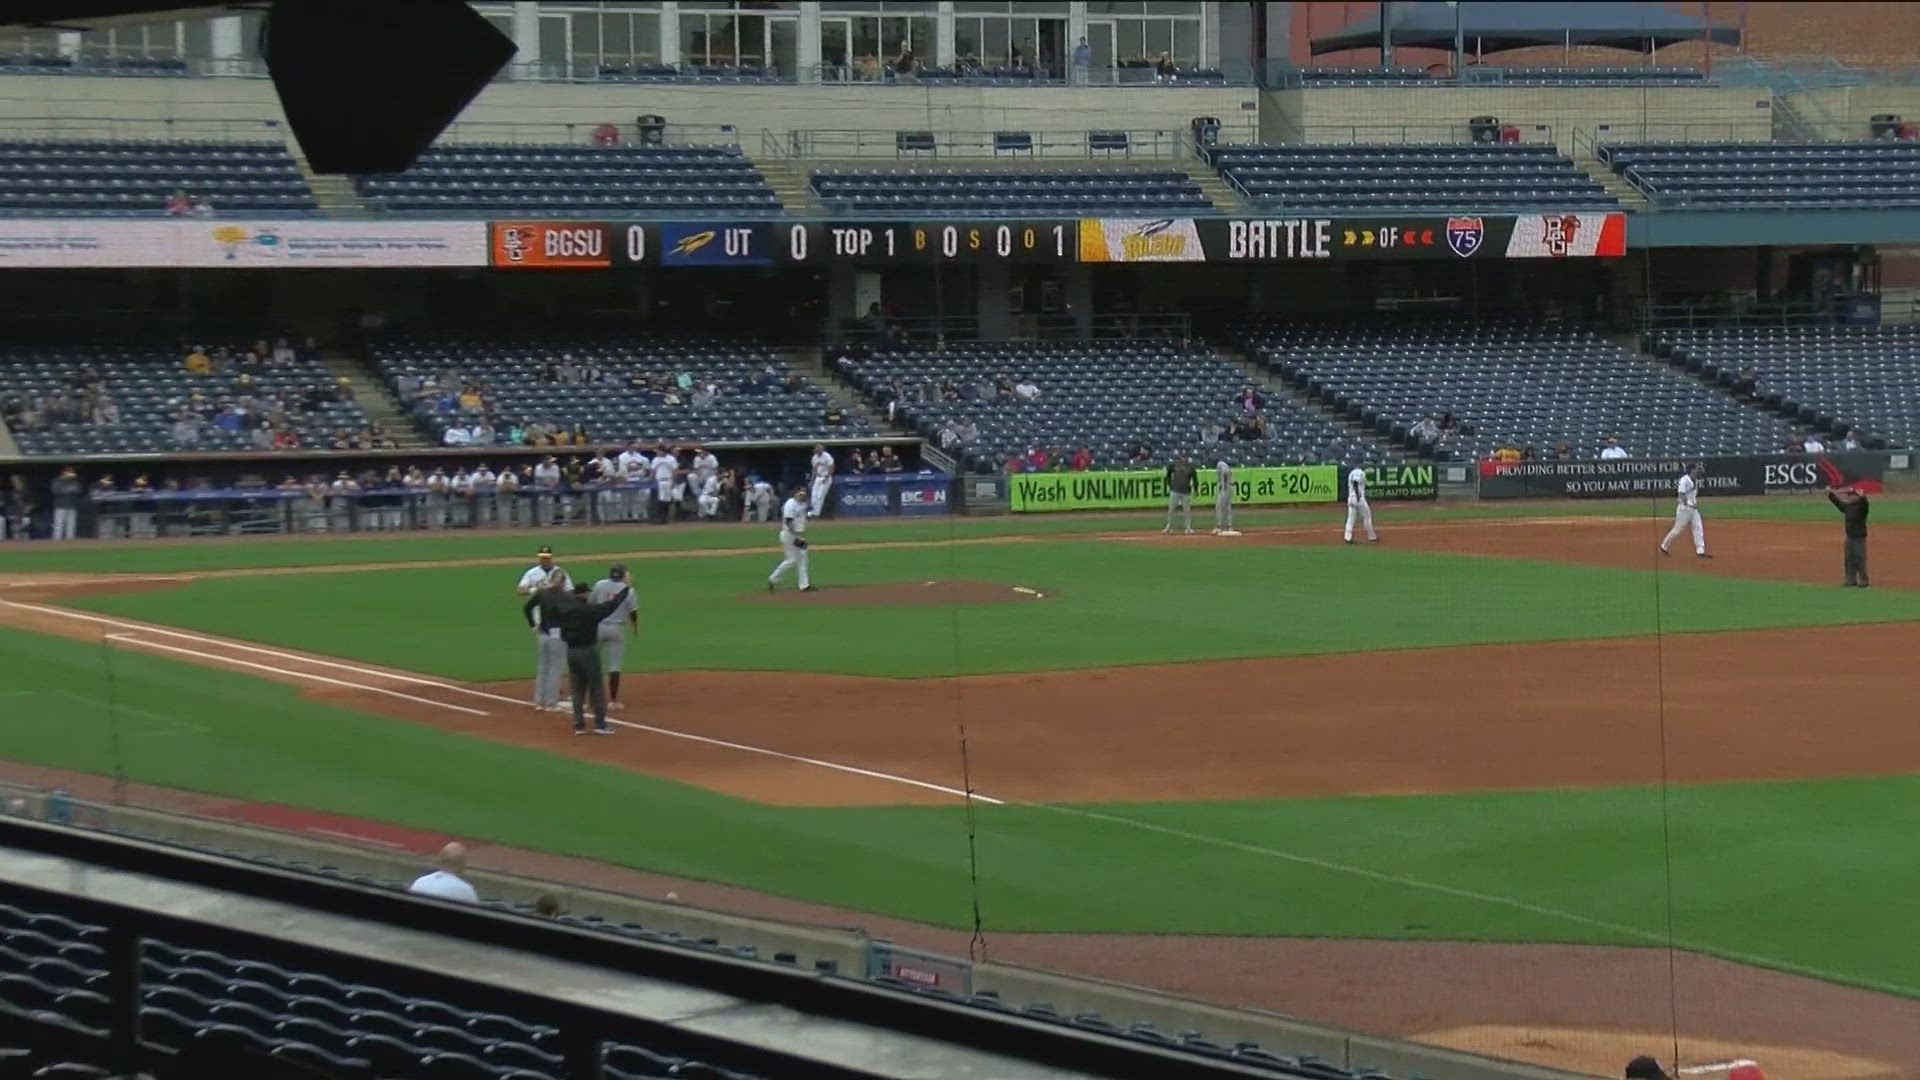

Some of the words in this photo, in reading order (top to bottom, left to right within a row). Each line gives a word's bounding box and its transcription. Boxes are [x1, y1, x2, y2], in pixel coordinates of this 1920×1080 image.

[545, 229, 602, 257] BGSU
[627, 225, 645, 261] 0
[724, 229, 753, 256] UT
[790, 224, 807, 260] 0
[832, 229, 874, 256] TOP
[884, 228, 895, 256] 1
[915, 230, 926, 249] B
[943, 225, 957, 257] 0
[970, 229, 980, 249] S
[997, 225, 1011, 257] 0
[1053, 225, 1063, 256] 1
[1229, 219, 1331, 258] BATTLE
[1379, 227, 1399, 246] OF
[1453, 230, 1477, 248] 75
[1364, 466, 1433, 486] CLEAN
[1496, 464, 1554, 476] PROVIDING
[1557, 464, 1595, 475] BETTER
[1597, 462, 1657, 474] SOLUTIONS
[1659, 462, 1680, 473] FOR
[1764, 463, 1818, 485] ESCS
[1019, 480, 1067, 502] Wash
[1257, 478, 1275, 496] at
[1386, 487, 1409, 496] AUTO
[1566, 481, 1581, 493] SO
[1583, 480, 1606, 492] YOU
[1607, 480, 1631, 491] MAY
[1633, 479, 1672, 490] BETTER
